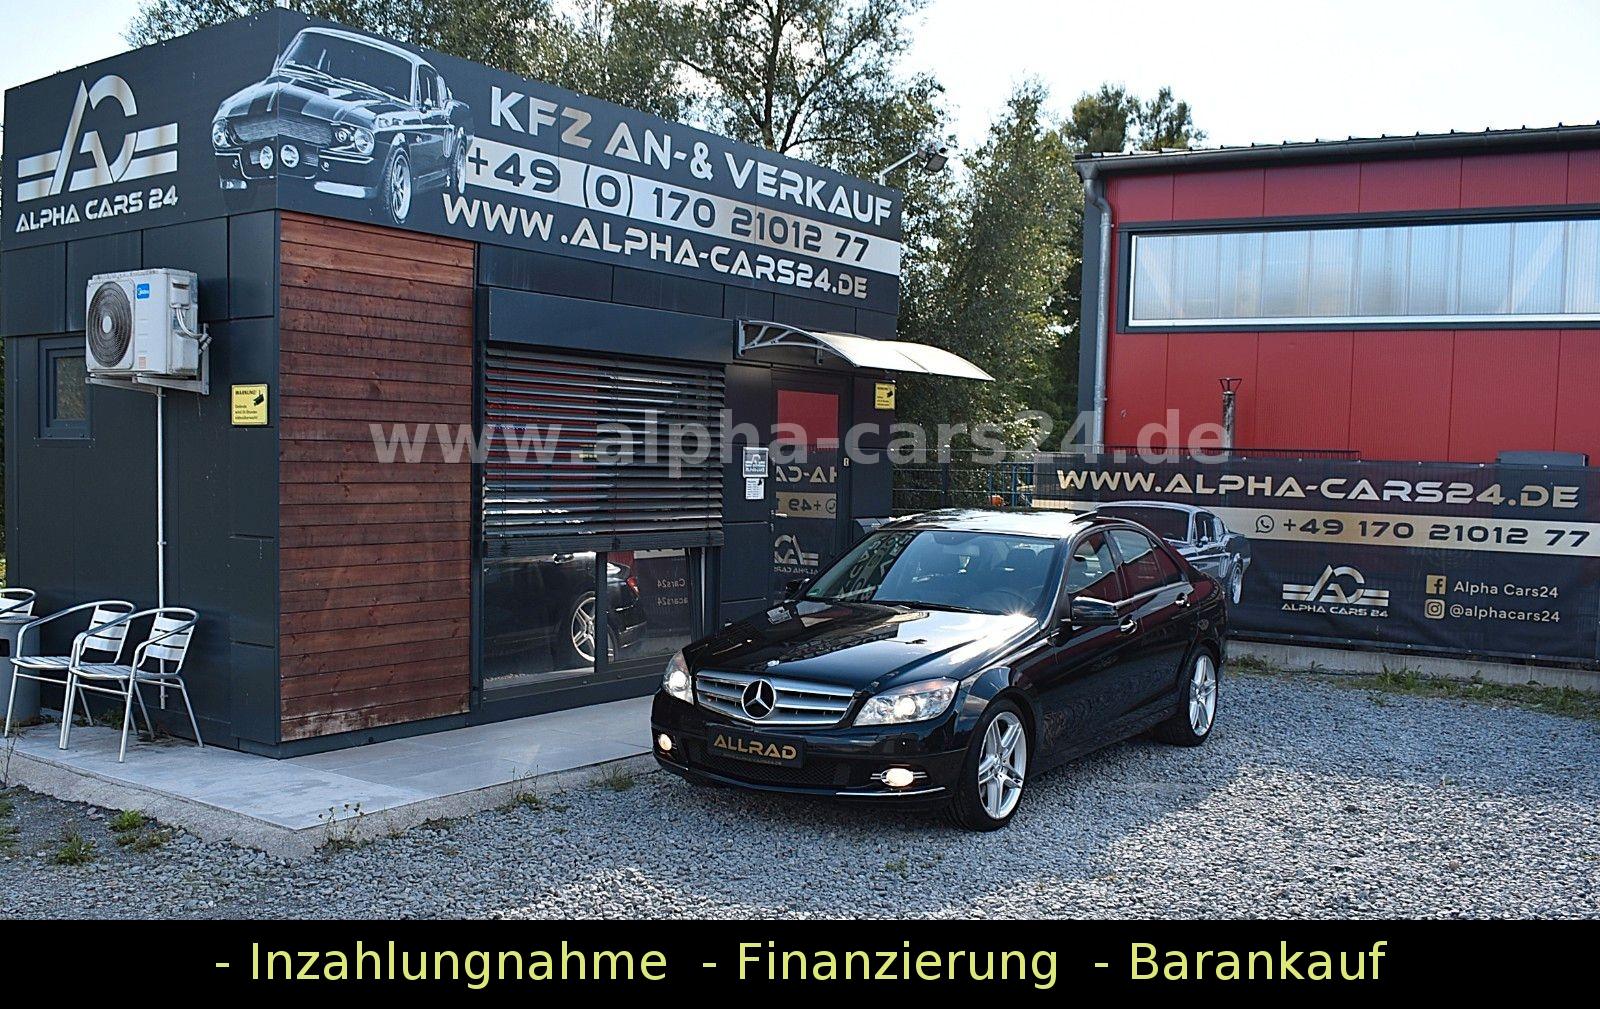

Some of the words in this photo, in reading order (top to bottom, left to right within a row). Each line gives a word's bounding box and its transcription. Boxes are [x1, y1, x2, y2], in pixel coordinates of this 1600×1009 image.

[490, 86, 593, 150] KFZ
[724, 152, 893, 226] VERKAUF
[16, 203, 80, 233] ALPHA
[85, 191, 143, 220] CARS
[149, 185, 179, 210] 24
[467, 146, 561, 193] +49
[583, 165, 633, 217] (0)
[653, 187, 716, 228] 170
[731, 206, 822, 253] 21012
[835, 233, 870, 262] 77
[1057, 470, 1580, 508] WWW.ALPHA-CARS24.DE
[1283, 518, 1344, 536] +49
[1358, 520, 1414, 539] 170
[1429, 524, 1528, 545] 21012
[1545, 529, 1590, 547] 77
[1453, 580, 1499, 596] Alpha
[1503, 583, 1559, 598] Cars24
[1281, 603, 1326, 613] ALPHA
[1329, 606, 1367, 616] CARS
[1370, 609, 1389, 618] 24
[1449, 603, 1560, 622] @alphacars24
[713, 734, 797, 760] ALLRAD
